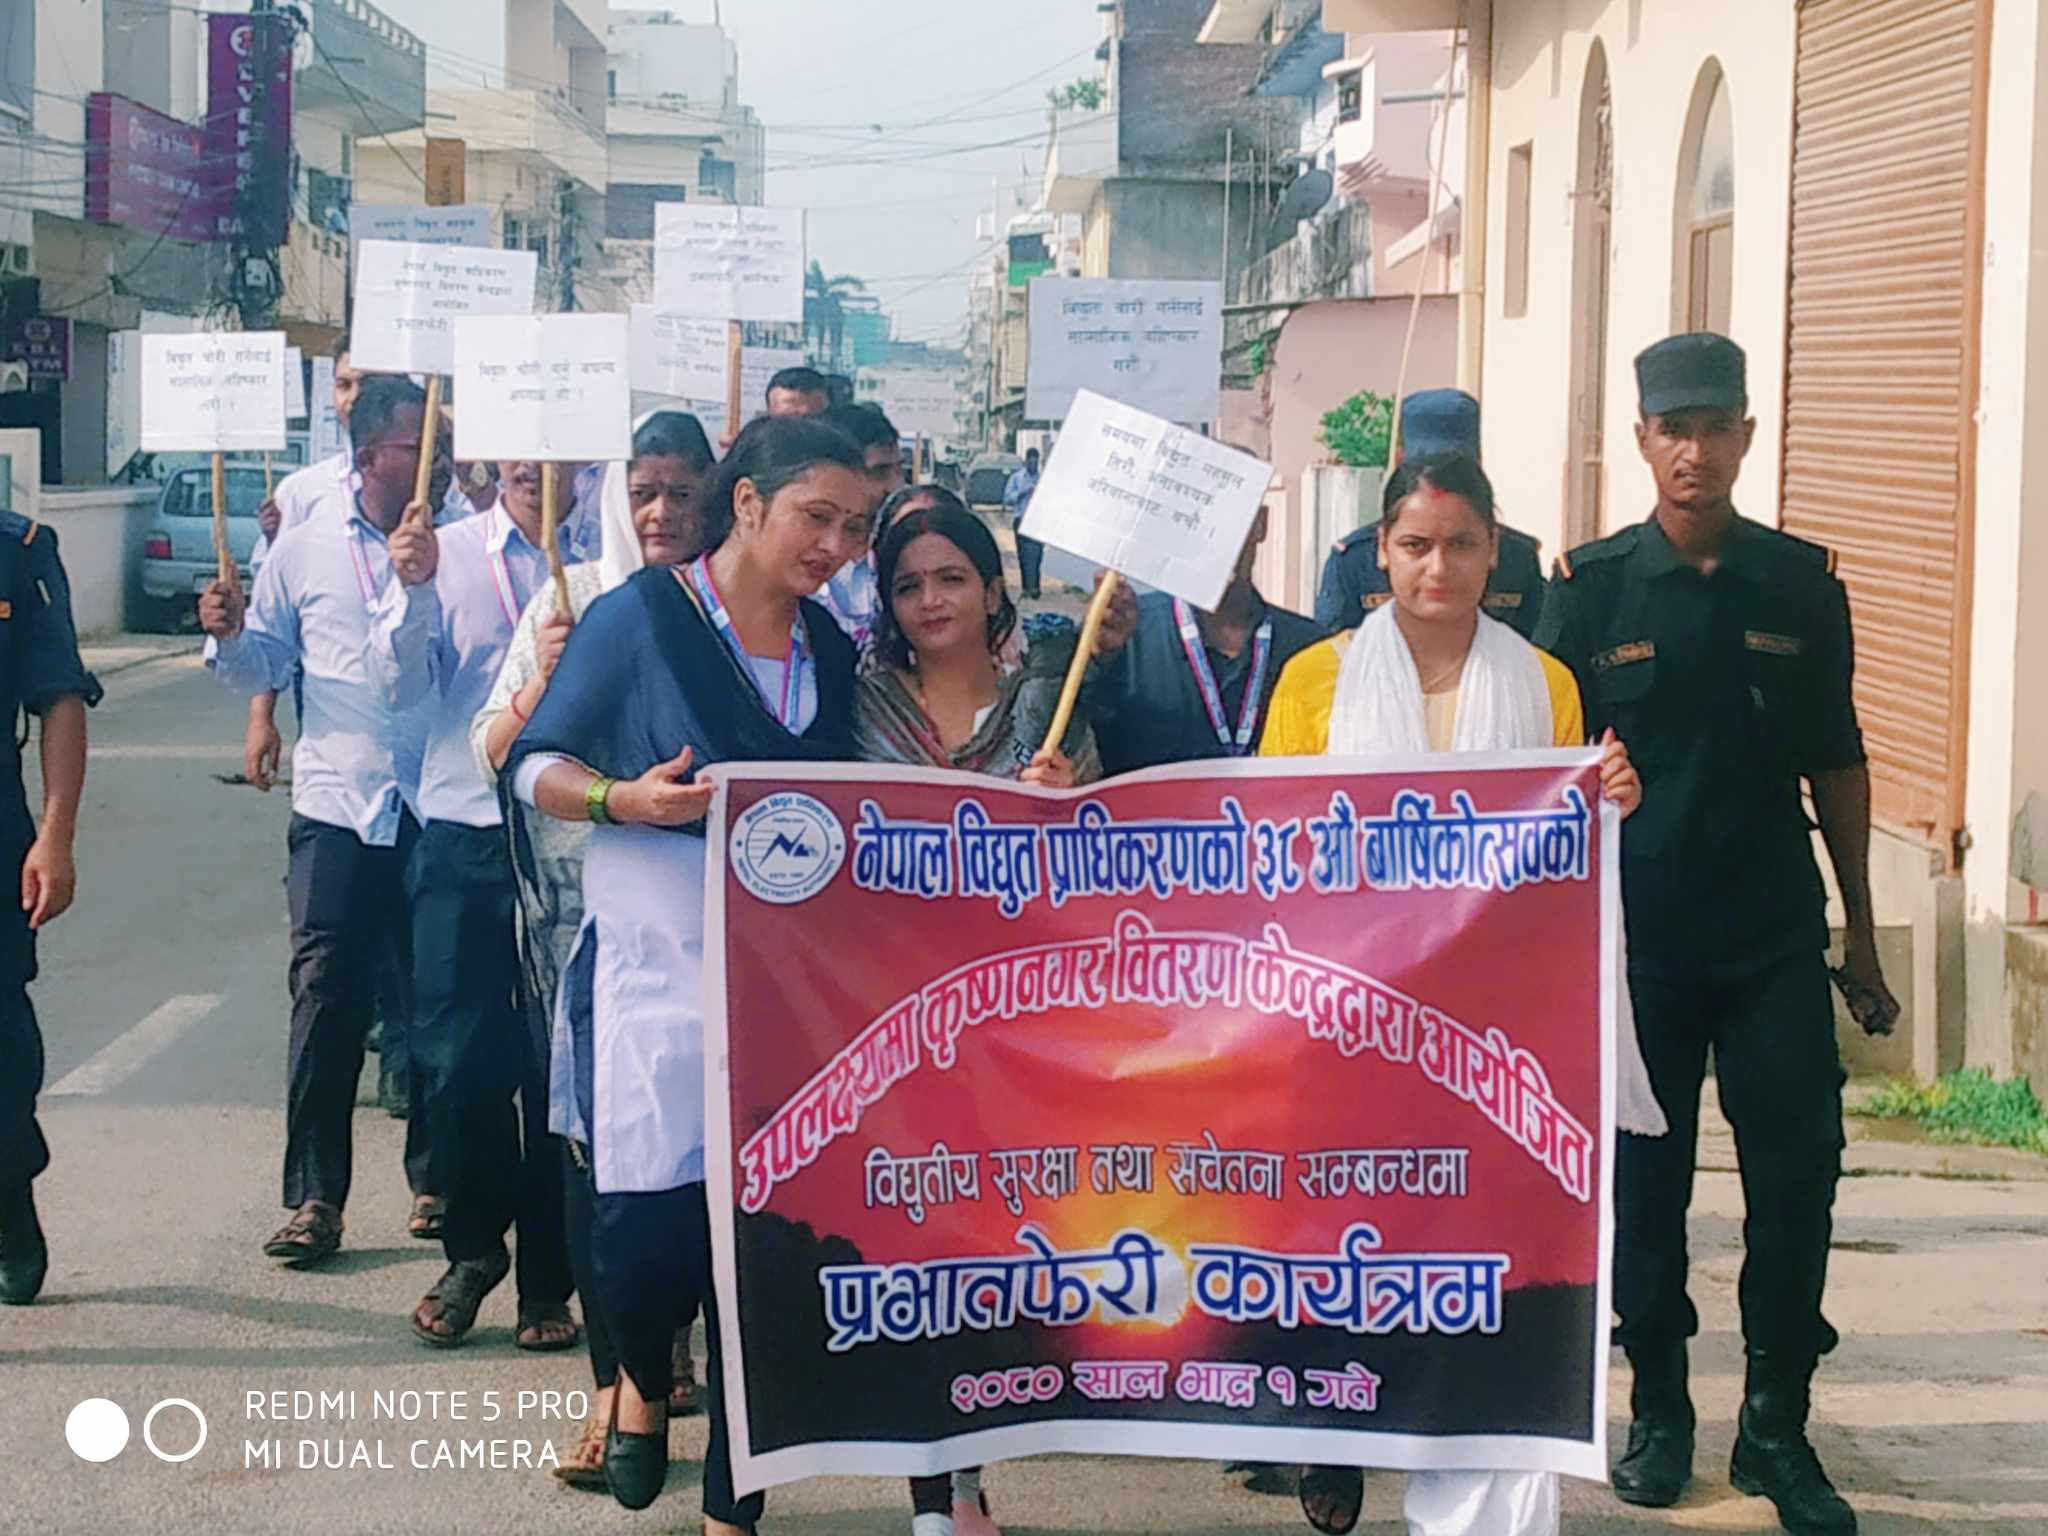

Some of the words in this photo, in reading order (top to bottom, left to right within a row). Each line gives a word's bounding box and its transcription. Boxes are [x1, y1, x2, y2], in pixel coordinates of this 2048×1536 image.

[853, 799, 953, 899] नेपाल
[954, 798, 1041, 919] विद्युत
[1042, 796, 1248, 908] प्राधिकरणको
[1252, 817, 1305, 902] ३८
[1360, 786, 1591, 892] बार्षिकोत्सवको
[920, 936, 1114, 1068] कृष्णनगर
[1113, 908, 1247, 1007] वितरण
[1418, 1005, 1593, 1202] आयोजित
[864, 1142, 980, 1224] विद्युतीय
[988, 1147, 1079, 1216] सुरक्षा
[1089, 1143, 1155, 1194] तथा
[1297, 1147, 1471, 1198] सम्बन्धमा
[819, 1223, 1168, 1351] प्रभातफेरी
[952, 1364, 1064, 1413] २०८०
[1072, 1360, 1168, 1401] साल
[1175, 1360, 1262, 1409] भाद्र
[1266, 1365, 1297, 1408] १
[1304, 1361, 1381, 1412] गते
